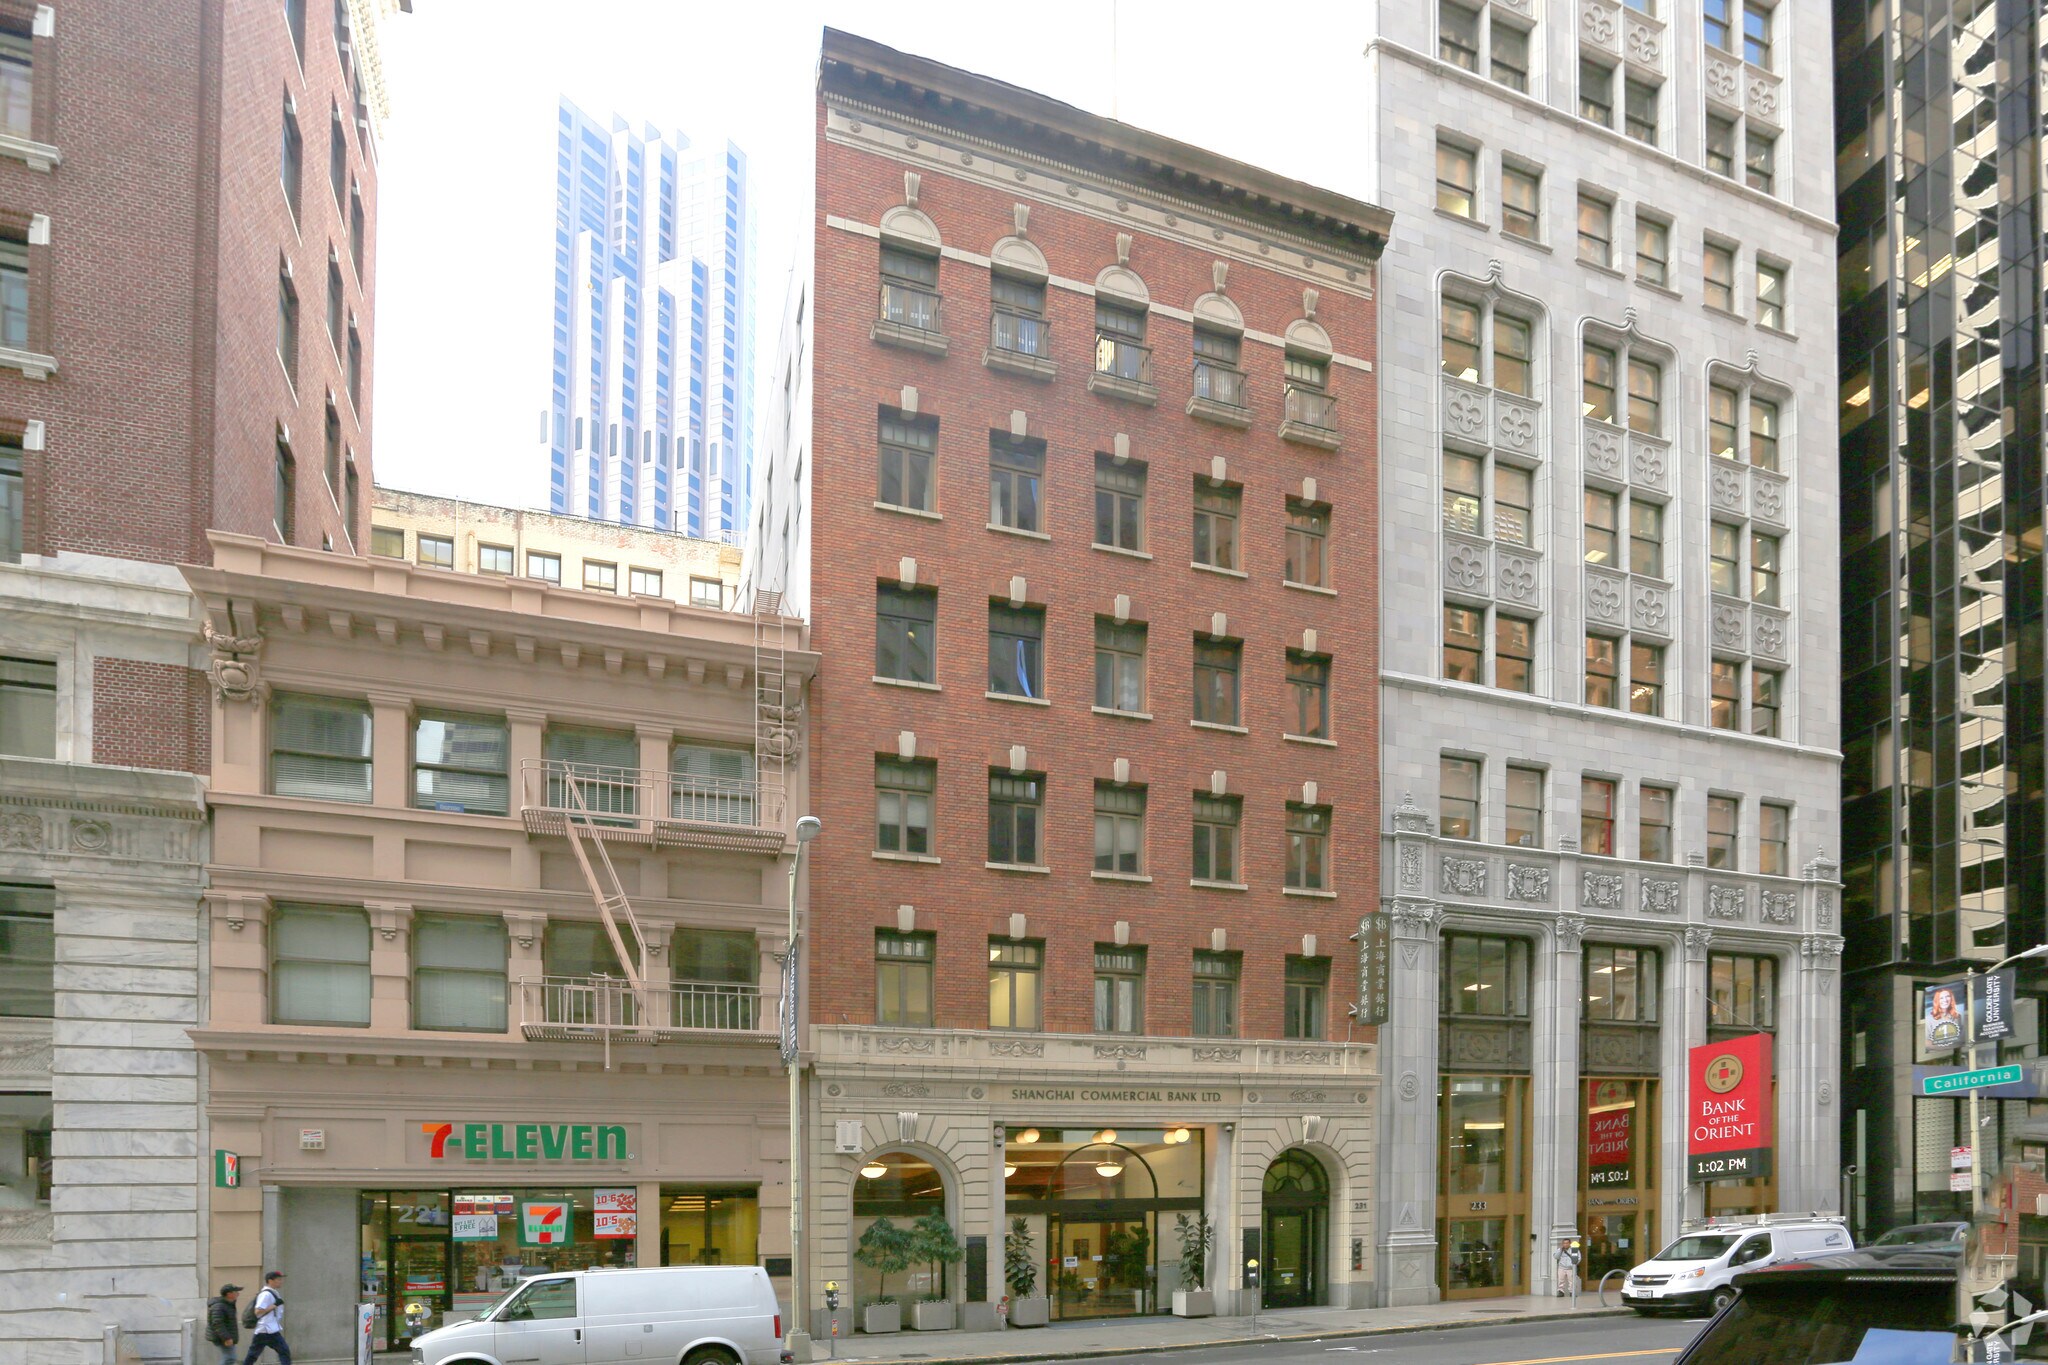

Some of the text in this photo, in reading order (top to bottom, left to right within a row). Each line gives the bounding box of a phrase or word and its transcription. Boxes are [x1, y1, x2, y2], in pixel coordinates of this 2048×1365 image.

[1986, 976, 1994, 995] GATE
[1993, 975, 2001, 1022] UNIVERSITY
[1933, 1070, 2012, 1089] California
[1012, 1089, 1222, 1102] SHANGHAI COMMERCIAL BANK LTD.
[1702, 1098, 1746, 1117] BANK
[1709, 1114, 1739, 1125] OF THE
[1694, 1122, 1755, 1141] ORIENT
[1698, 1157, 1747, 1174] 1:02 PM
[398, 1204, 442, 1223] 221
[1354, 1202, 1367, 1210] 231
[1471, 1201, 1487, 1211] 233
[459, 1223, 476, 1231] FREE
[529, 1205, 562, 1244] 7
[596, 1217, 608, 1227] 10
